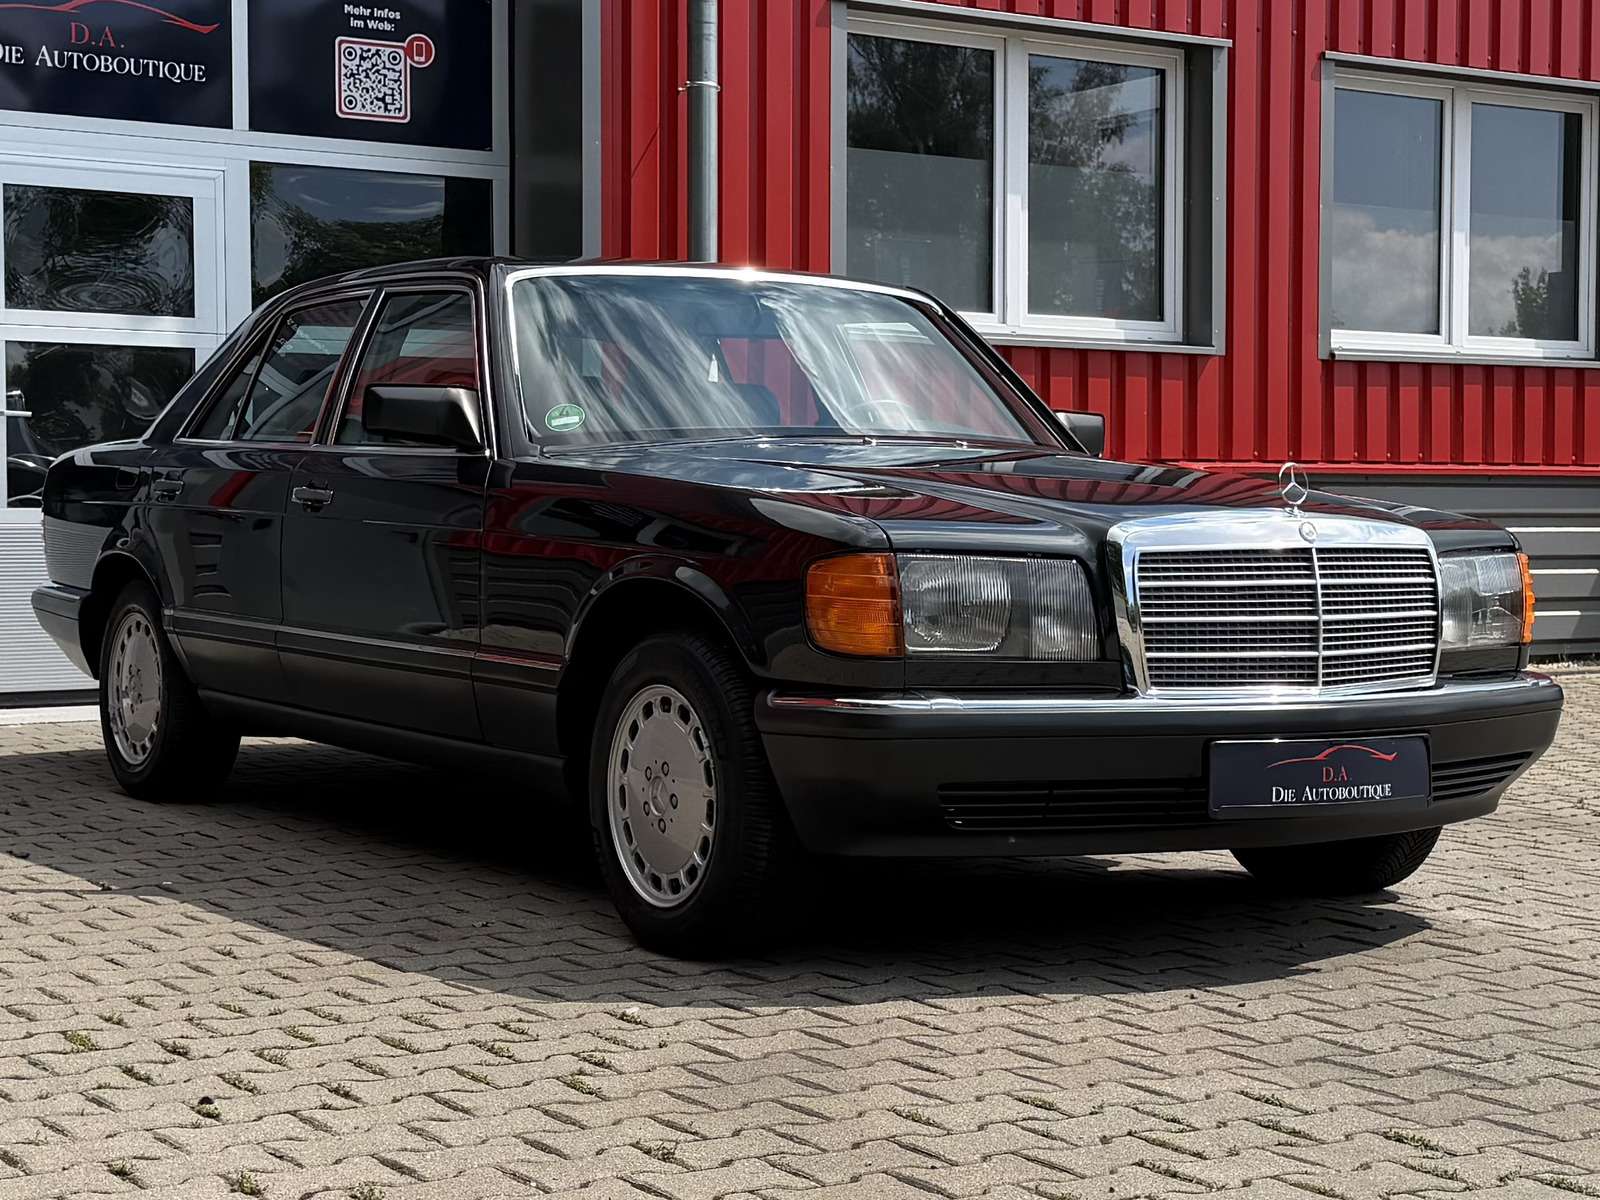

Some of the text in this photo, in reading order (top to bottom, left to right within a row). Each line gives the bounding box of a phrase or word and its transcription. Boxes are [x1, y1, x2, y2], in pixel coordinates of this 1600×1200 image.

[344, 4, 401, 19] Mehr Infos
[366, 19, 395, 31] Web:
[70, 22, 125, 48] D.A.
[35, 45, 206, 82] AUTOBOUTIQUE
[1272, 783, 1392, 802] DIE AUTOBOUTIQUE
